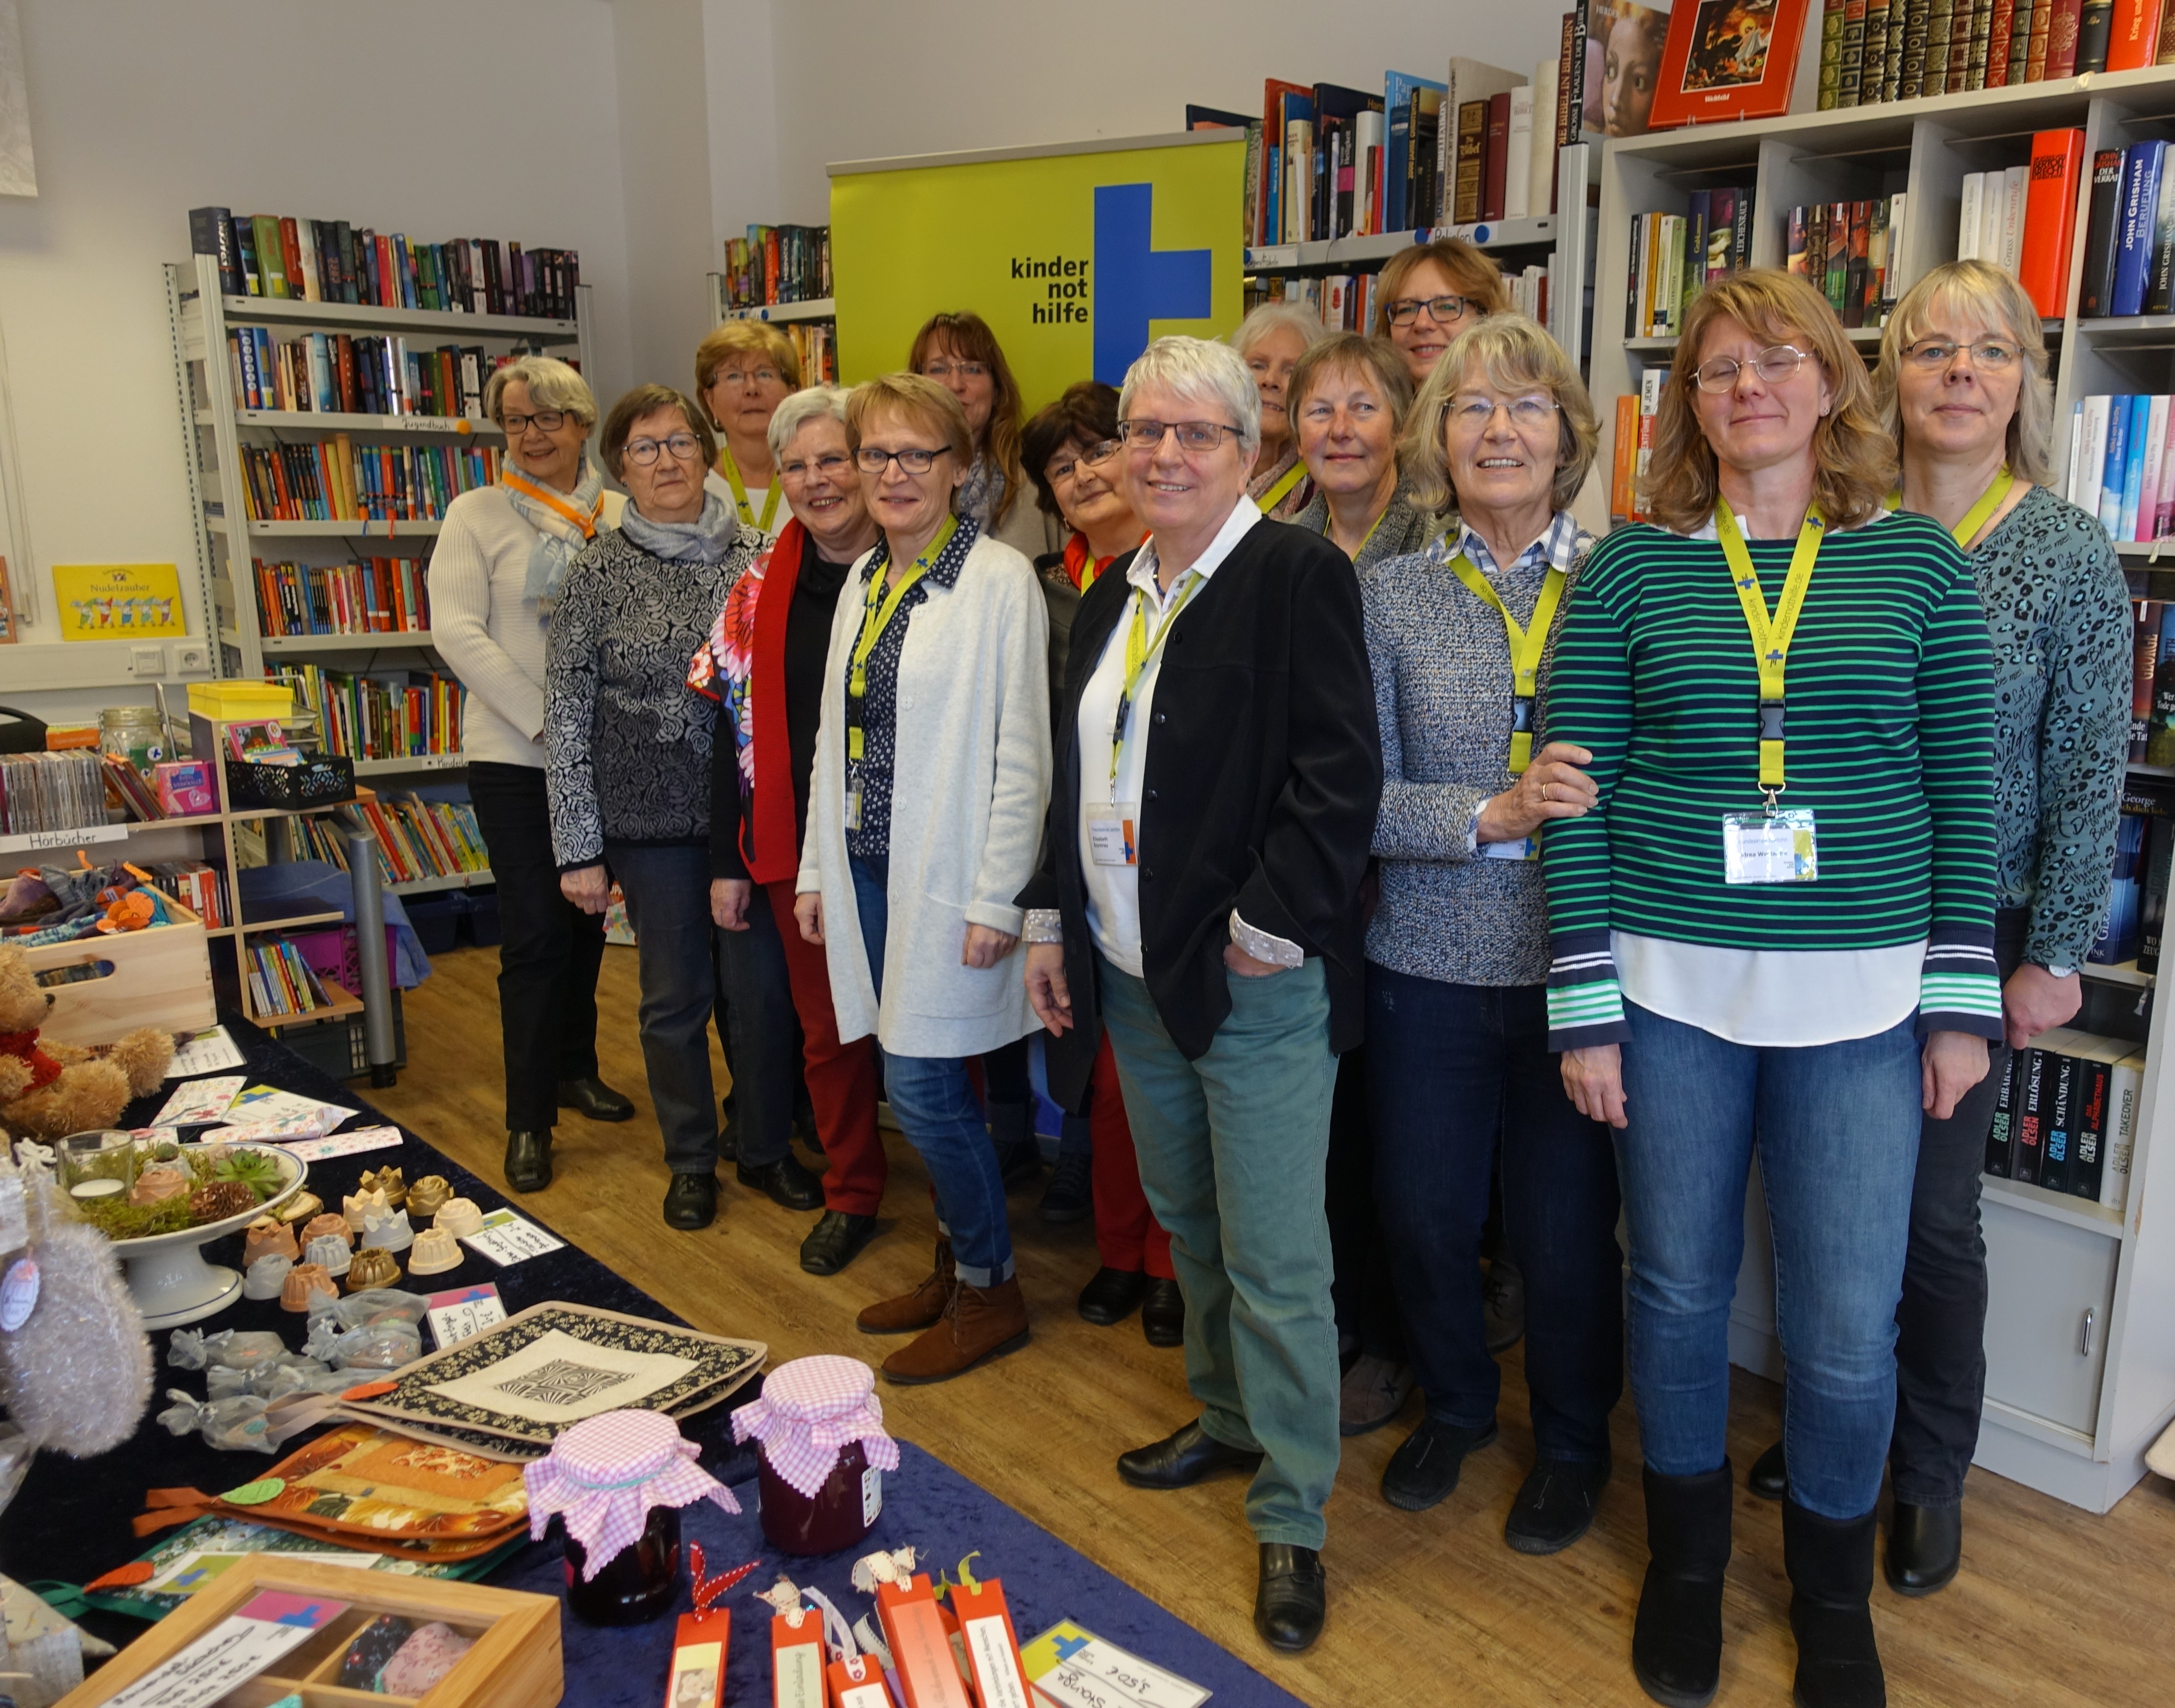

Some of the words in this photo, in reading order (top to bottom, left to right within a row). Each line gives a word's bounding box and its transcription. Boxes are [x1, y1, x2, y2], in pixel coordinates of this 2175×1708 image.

[1575, 6, 1586, 38] BIBEL
[2130, 17, 2142, 41] Krieg
[1562, 19, 1574, 74] BILDERN
[1562, 76, 1570, 89] IN
[1570, 59, 1583, 105] FRAUEN
[1559, 91, 1570, 125] BIBEL
[1570, 106, 1579, 141] GROSSE
[2032, 166, 2064, 177] BRECHT
[2129, 159, 2143, 215] GRISHAM
[2006, 180, 2020, 236] Unkenrufe
[2136, 170, 2152, 238] BERUFUNG
[2125, 219, 2136, 250] JOHN
[2162, 227, 2173, 266] GRISHAM
[1012, 256, 1088, 279] kinder
[2004, 238, 2014, 267] Grass
[1048, 278, 1087, 298] not
[2159, 267, 2168, 290] JOHN
[1033, 302, 1088, 324] hilfe
[402, 418, 450, 431] Jugendbuch
[1644, 405, 1649, 414] IM
[89, 583, 151, 593] Nudelzauber
[1776, 573, 1804, 640] kindernothilfe.de
[2140, 633, 2158, 680] GEORGE
[2137, 731, 2148, 741] Tat
[2122, 792, 2155, 805] George
[30, 832, 96, 849] Hörbücher
[2146, 935, 2157, 945] WO
[2028, 1058, 2042, 1112] ERLÖSUNG
[2056, 1065, 2071, 1127] SCHÄNDUNG
[2091, 1074, 2104, 1130] ALPHABETHAUS
[2119, 1089, 2133, 1137] TAKEOVER
[1993, 1112, 2002, 1140] ADLER
[2000, 1113, 2010, 1142] OLSEN
[2021, 1116, 2031, 1144] ADLER
[2029, 1117, 2039, 1146] OLSEN
[2049, 1130, 2059, 1160] ADLER
[2056, 1132, 2067, 1162] OLSEN
[2079, 1131, 2090, 1162] ADLER
[2087, 1133, 2097, 1163] OLSEN
[2112, 1143, 2124, 1173] ADLER
[2119, 1144, 2131, 1175] OLSEN
